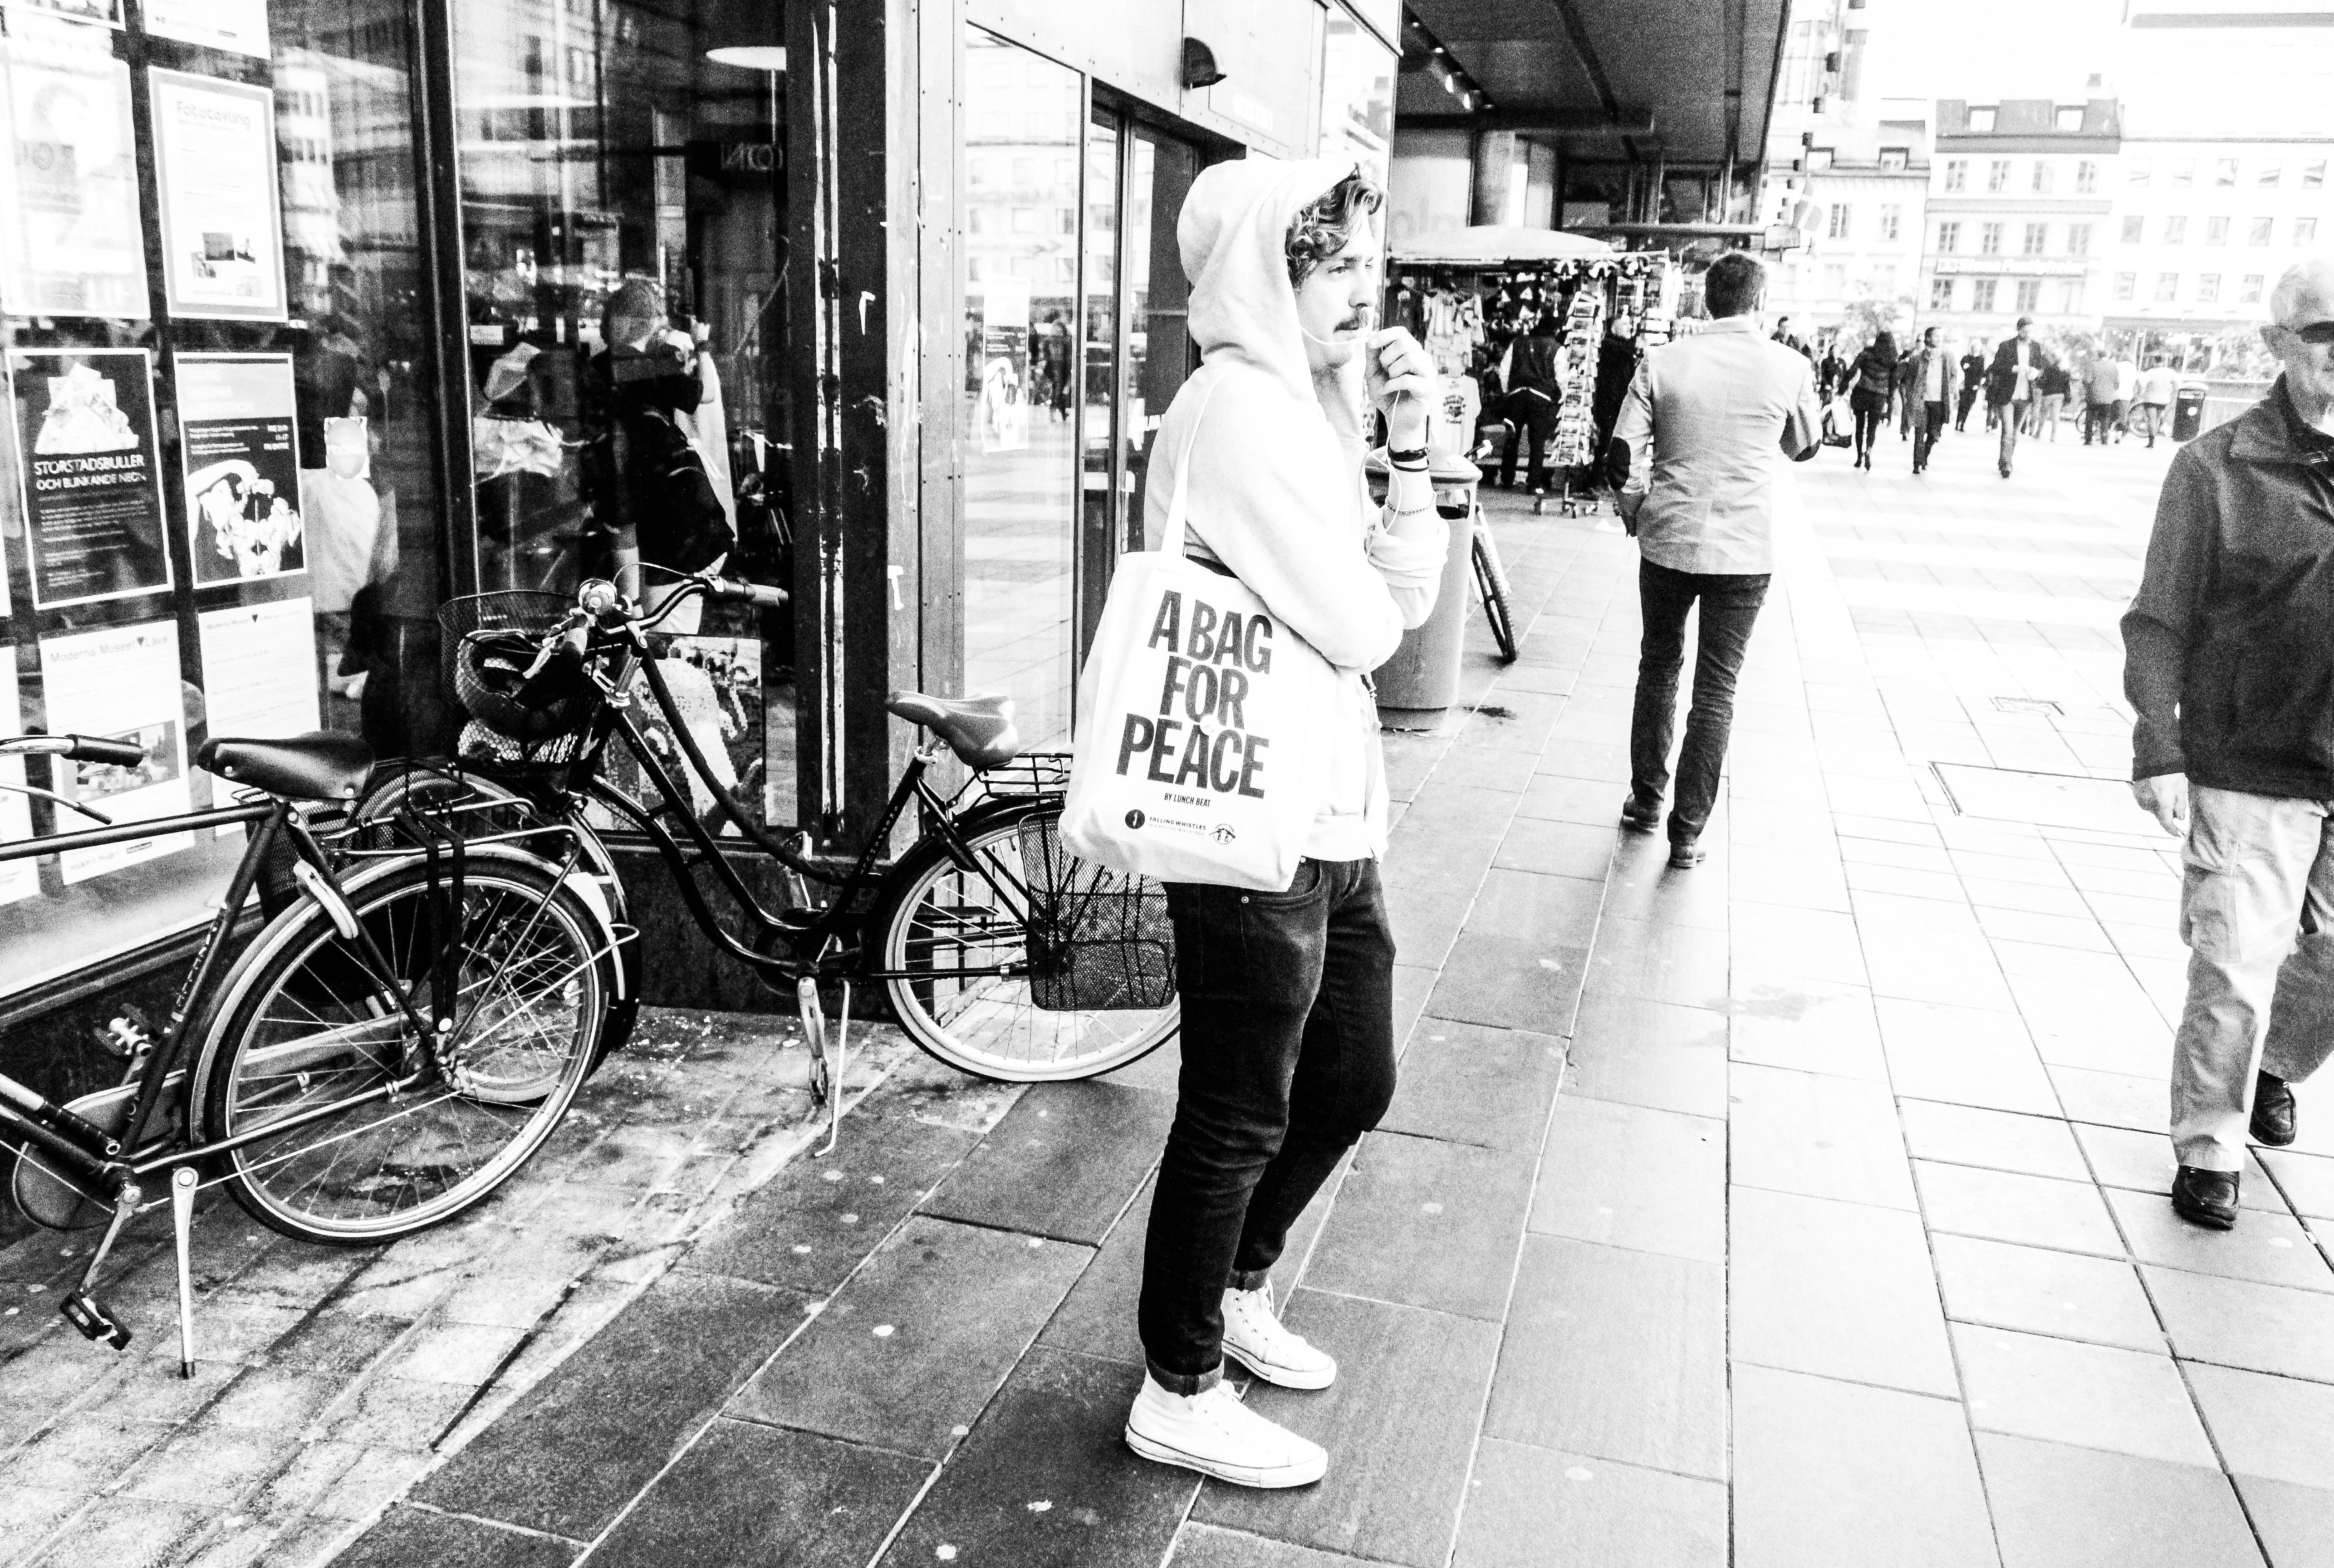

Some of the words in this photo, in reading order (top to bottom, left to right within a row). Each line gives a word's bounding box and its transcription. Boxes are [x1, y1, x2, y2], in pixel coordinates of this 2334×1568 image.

[177, 100, 250, 130] Fototävling
[188, 401, 254, 415] COMPETITION
[34, 454, 145, 475] STORSTADSBULLER
[36, 479, 61, 490] OCH
[63, 474, 117, 488] BLINKANDE
[1148, 590, 1182, 652] A
[1187, 599, 1273, 675] BAG
[50, 648, 96, 662] Moderna
[99, 640, 136, 654] Museet
[145, 636, 167, 647] Lava
[1159, 656, 1249, 730] FOR
[1116, 712, 1270, 799] PEACE
[1164, 793, 1172, 802] BY
[1174, 794, 1194, 805] LUNCH
[1196, 798, 1211, 808] BEAT
[1150, 817, 1174, 825] FALLING
[1176, 821, 1206, 830] WHISTLES
